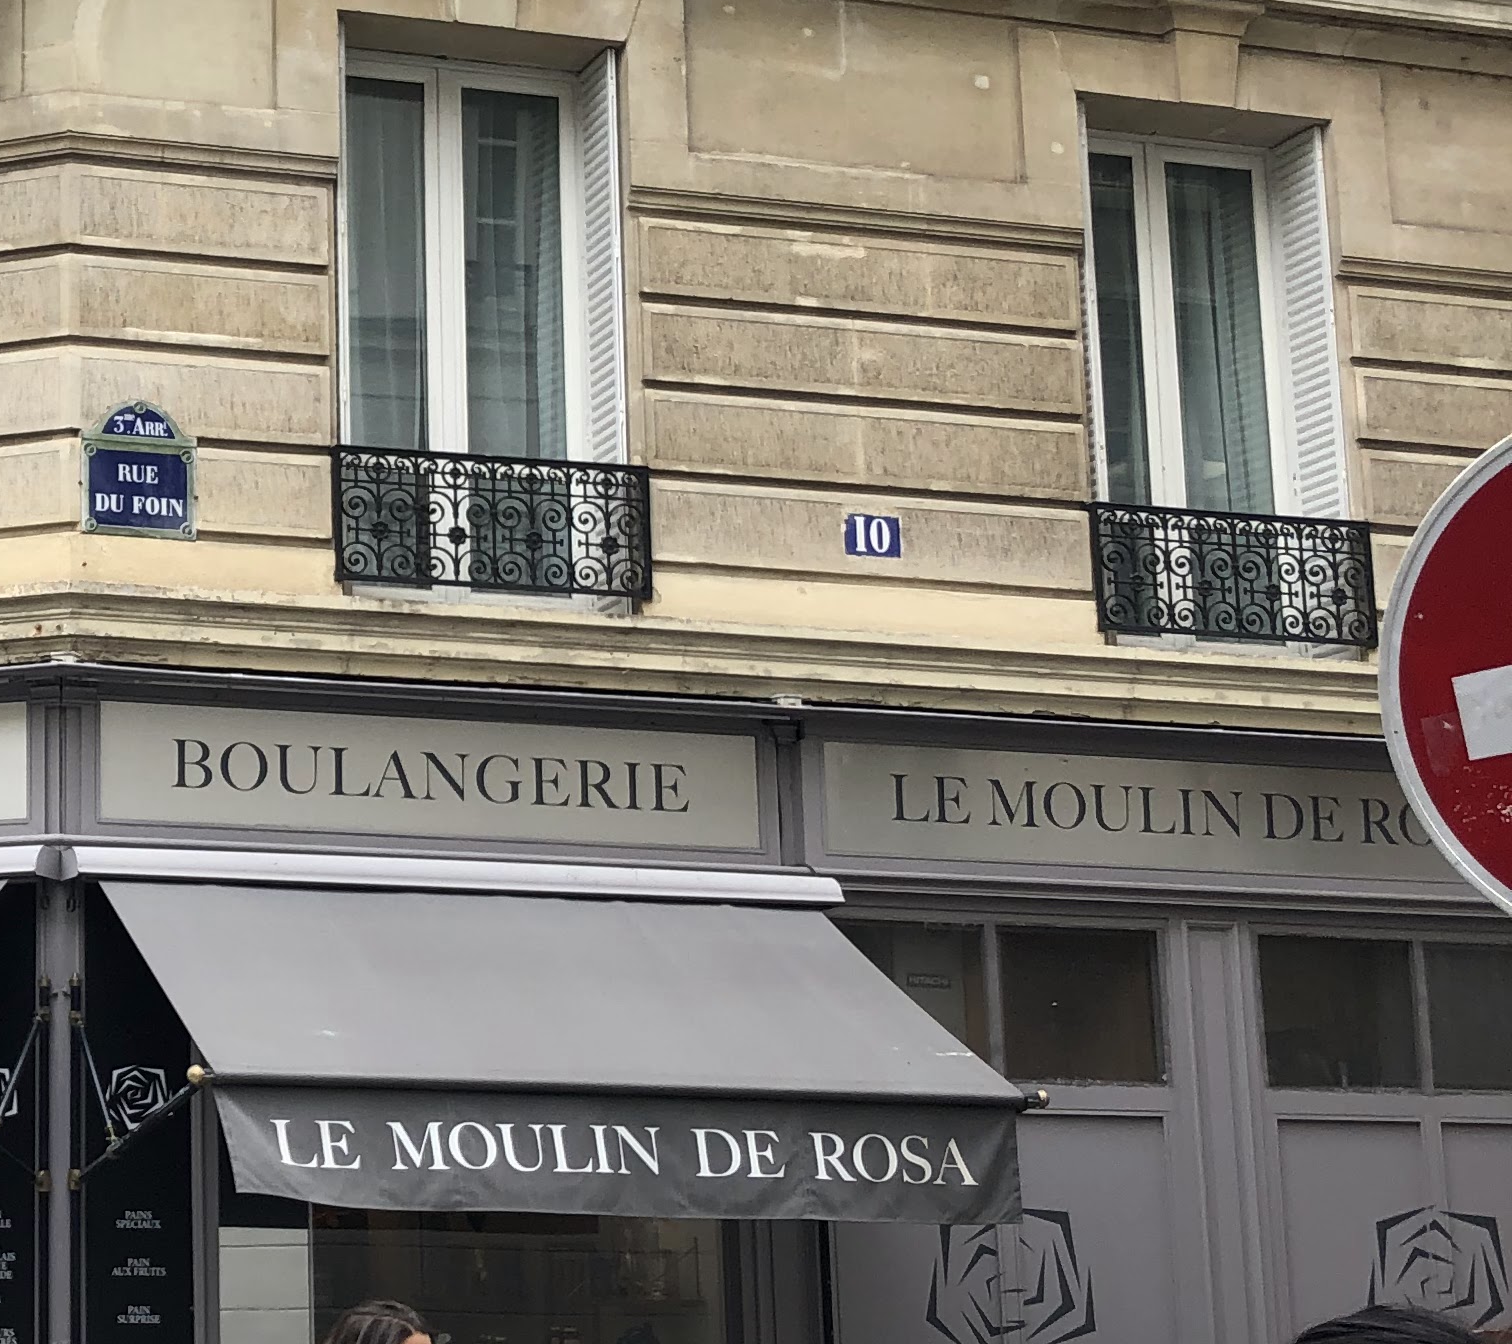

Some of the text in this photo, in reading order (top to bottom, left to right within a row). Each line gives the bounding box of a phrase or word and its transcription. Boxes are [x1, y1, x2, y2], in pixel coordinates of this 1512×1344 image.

[118, 463, 159, 484] RUE
[95, 493, 183, 517] DU FOIN
[854, 516, 891, 553] 10
[173, 737, 691, 815] BOULANGERIE
[890, 773, 970, 824] LE
[988, 778, 1243, 838] MOULIN
[1264, 792, 1344, 844] DE
[269, 1119, 980, 1187] LE MOULIN DE ROSA
[125, 1210, 153, 1220] PAINS
[111, 1267, 167, 1276] AUX FRUITS
[127, 1257, 150, 1267] PAIN
[116, 1314, 161, 1324] SURPRISE
[127, 1305, 151, 1315] PAIN
